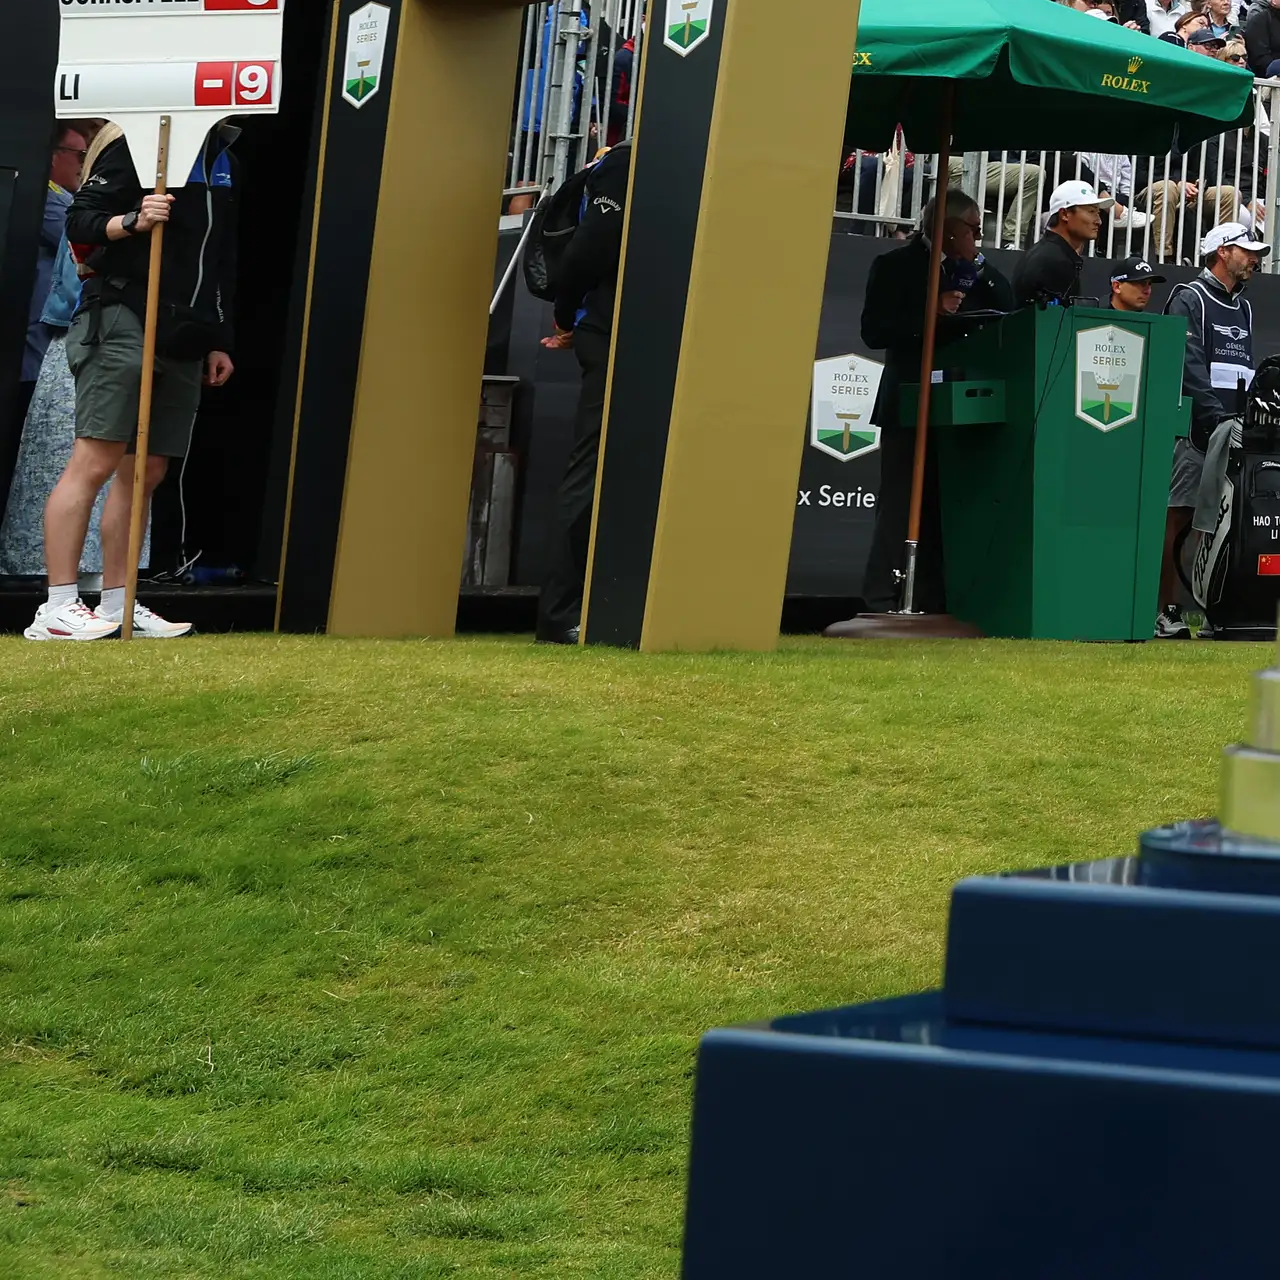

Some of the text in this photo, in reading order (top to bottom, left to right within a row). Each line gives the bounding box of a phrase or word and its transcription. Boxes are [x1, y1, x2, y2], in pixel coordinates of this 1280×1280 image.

[359, 20, 378, 31] ROLEX
[357, 32, 378, 44] SERIES
[59, 73, 80, 101] LI
[1101, 73, 1151, 94] ROLEX
[1094, 344, 1126, 354] ROLEX
[1093, 356, 1127, 367] SERIES
[833, 373, 869, 383] ROLEX
[831, 385, 870, 396] SERIES
[1253, 516, 1271, 526] HAO
[1271, 529, 1278, 540] LI
